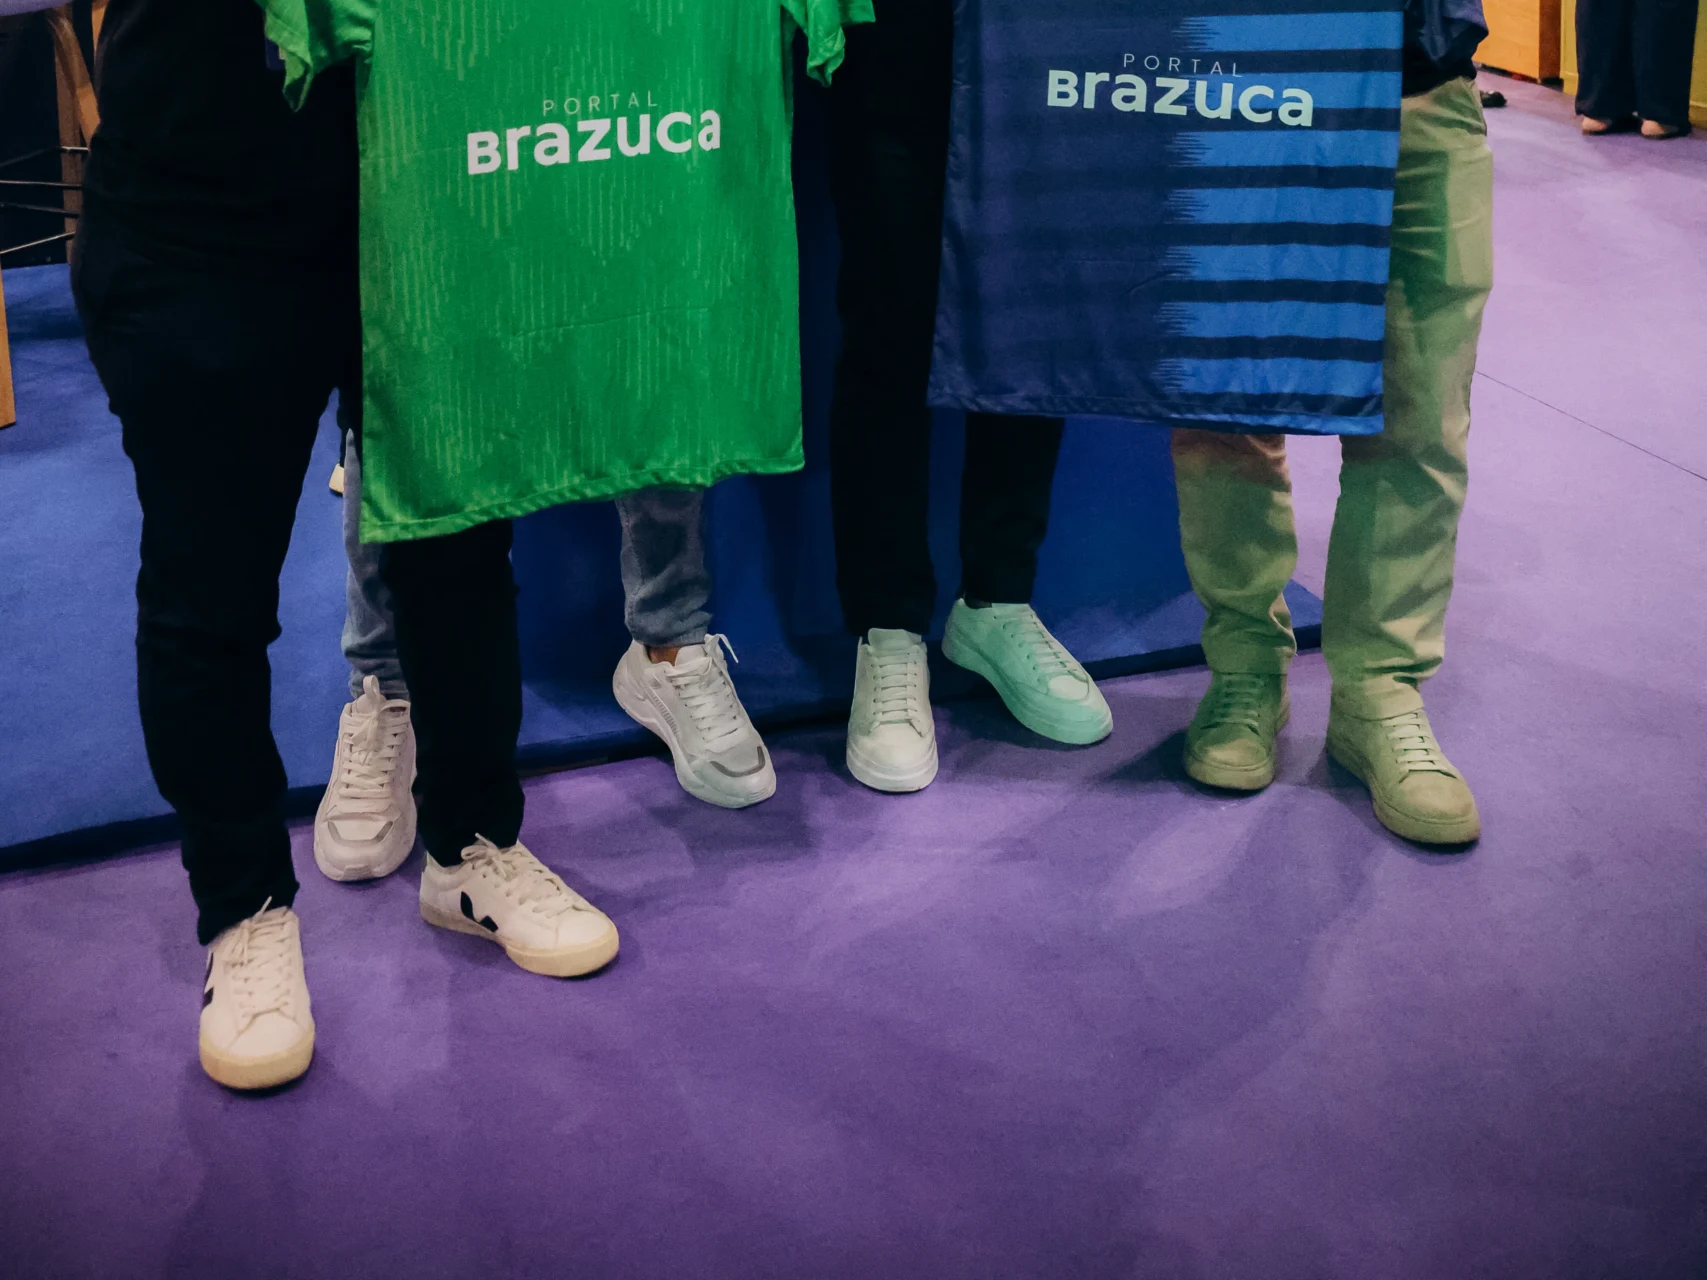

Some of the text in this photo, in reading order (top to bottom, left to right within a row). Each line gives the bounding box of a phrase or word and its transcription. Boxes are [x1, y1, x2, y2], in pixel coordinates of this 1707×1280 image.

[1123, 53, 1242, 78] PORTAL
[543, 91, 657, 116] PORTAL
[1047, 70, 1313, 127] Brazuca
[467, 109, 721, 175] Brazuca
